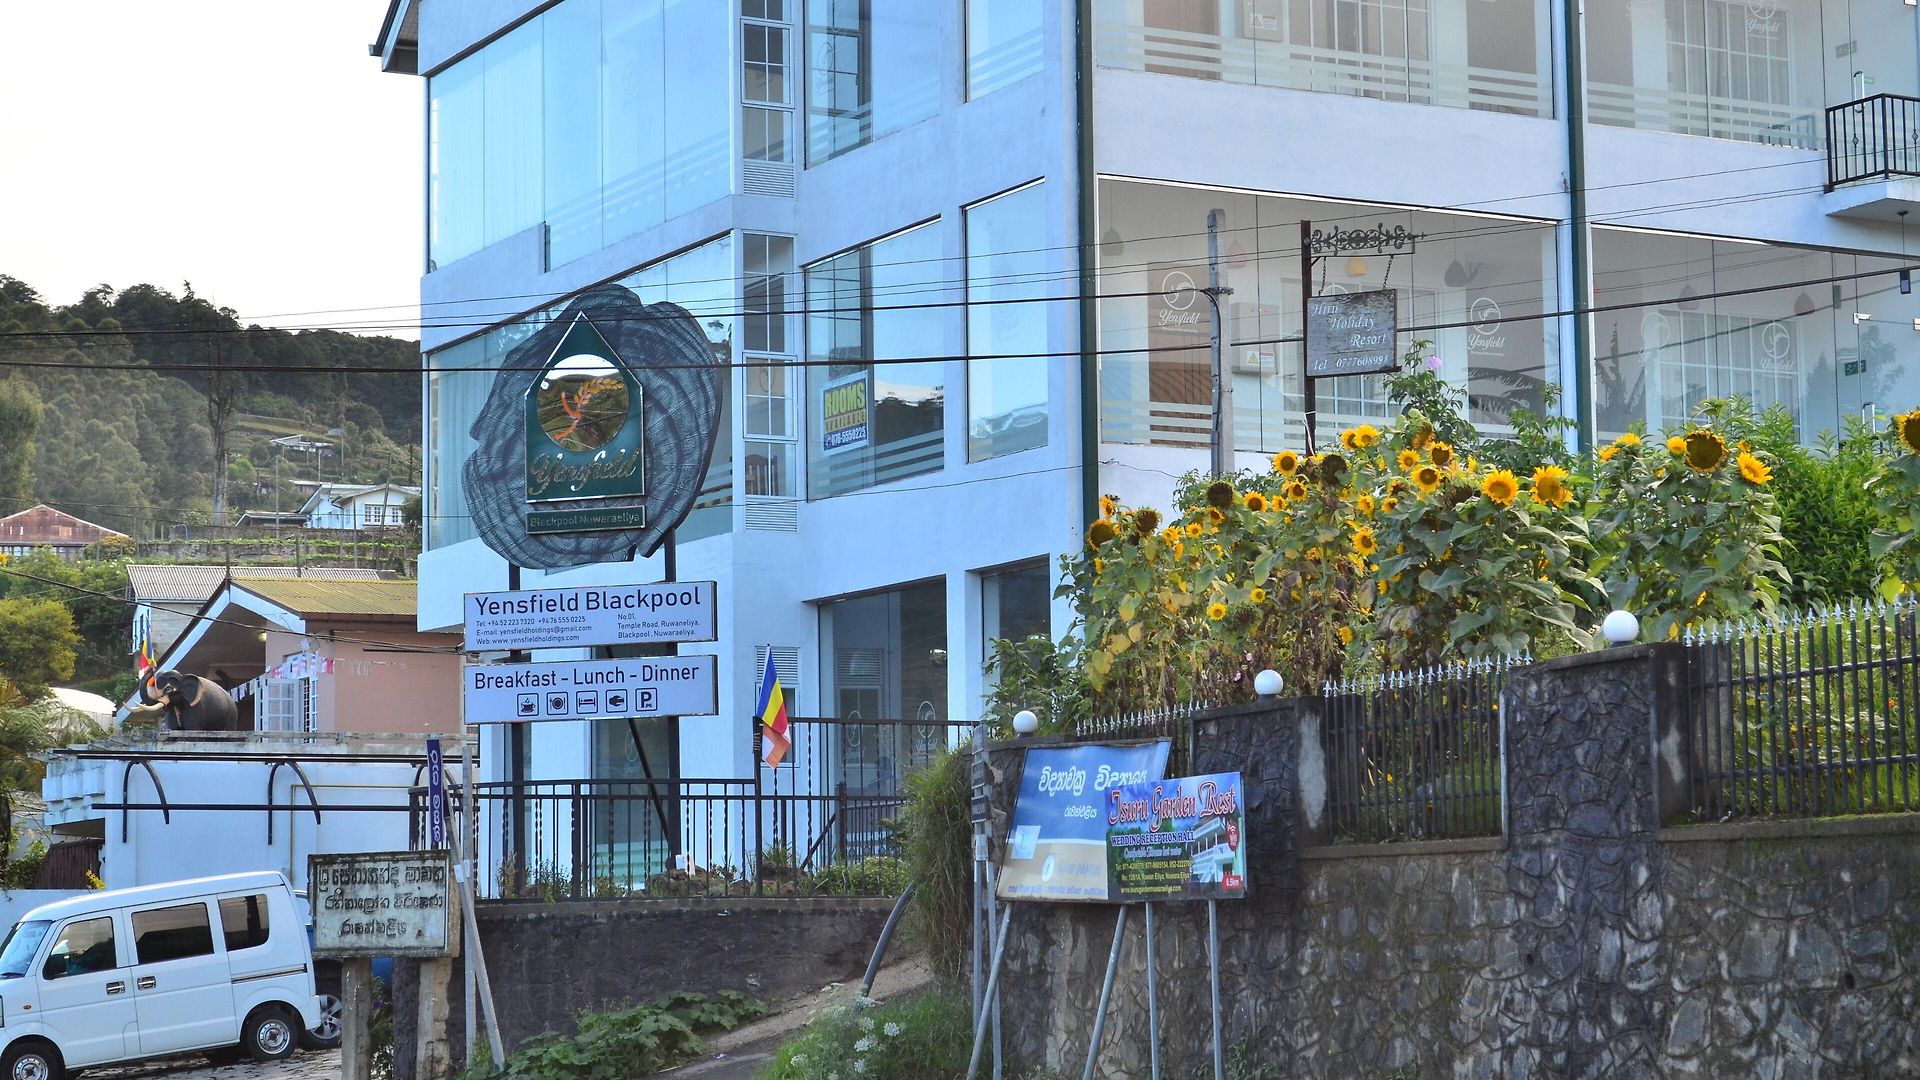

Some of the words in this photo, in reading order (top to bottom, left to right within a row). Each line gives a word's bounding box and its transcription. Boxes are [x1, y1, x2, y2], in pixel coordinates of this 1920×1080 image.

[1330, 313, 1375, 331] Holiday
[1350, 333, 1387, 348] Resort
[824, 382, 866, 418] ROOMS
[528, 448, 640, 495] Yensfield
[530, 515, 578, 527] Blackpool
[580, 513, 640, 525] Nuwaraeliya
[475, 592, 579, 616] Yensfield
[585, 586, 701, 613] Blackpool
[499, 625, 593, 636] yensfieldholdings@gmail.com
[617, 622, 641, 630] Temple
[491, 634, 580, 645] www.yensfieldholdings.com
[475, 669, 557, 690] Breakfast
[573, 666, 625, 686] Lunch
[642, 664, 700, 682] Dinner
[1109, 789, 1148, 825] Isuru
[1149, 783, 1197, 832] Garden
[1198, 780, 1236, 817] Rest
[1111, 834, 1141, 847] WEDDING
[1141, 831, 1177, 846] RECEPTION
[1177, 830, 1195, 842] HALL
